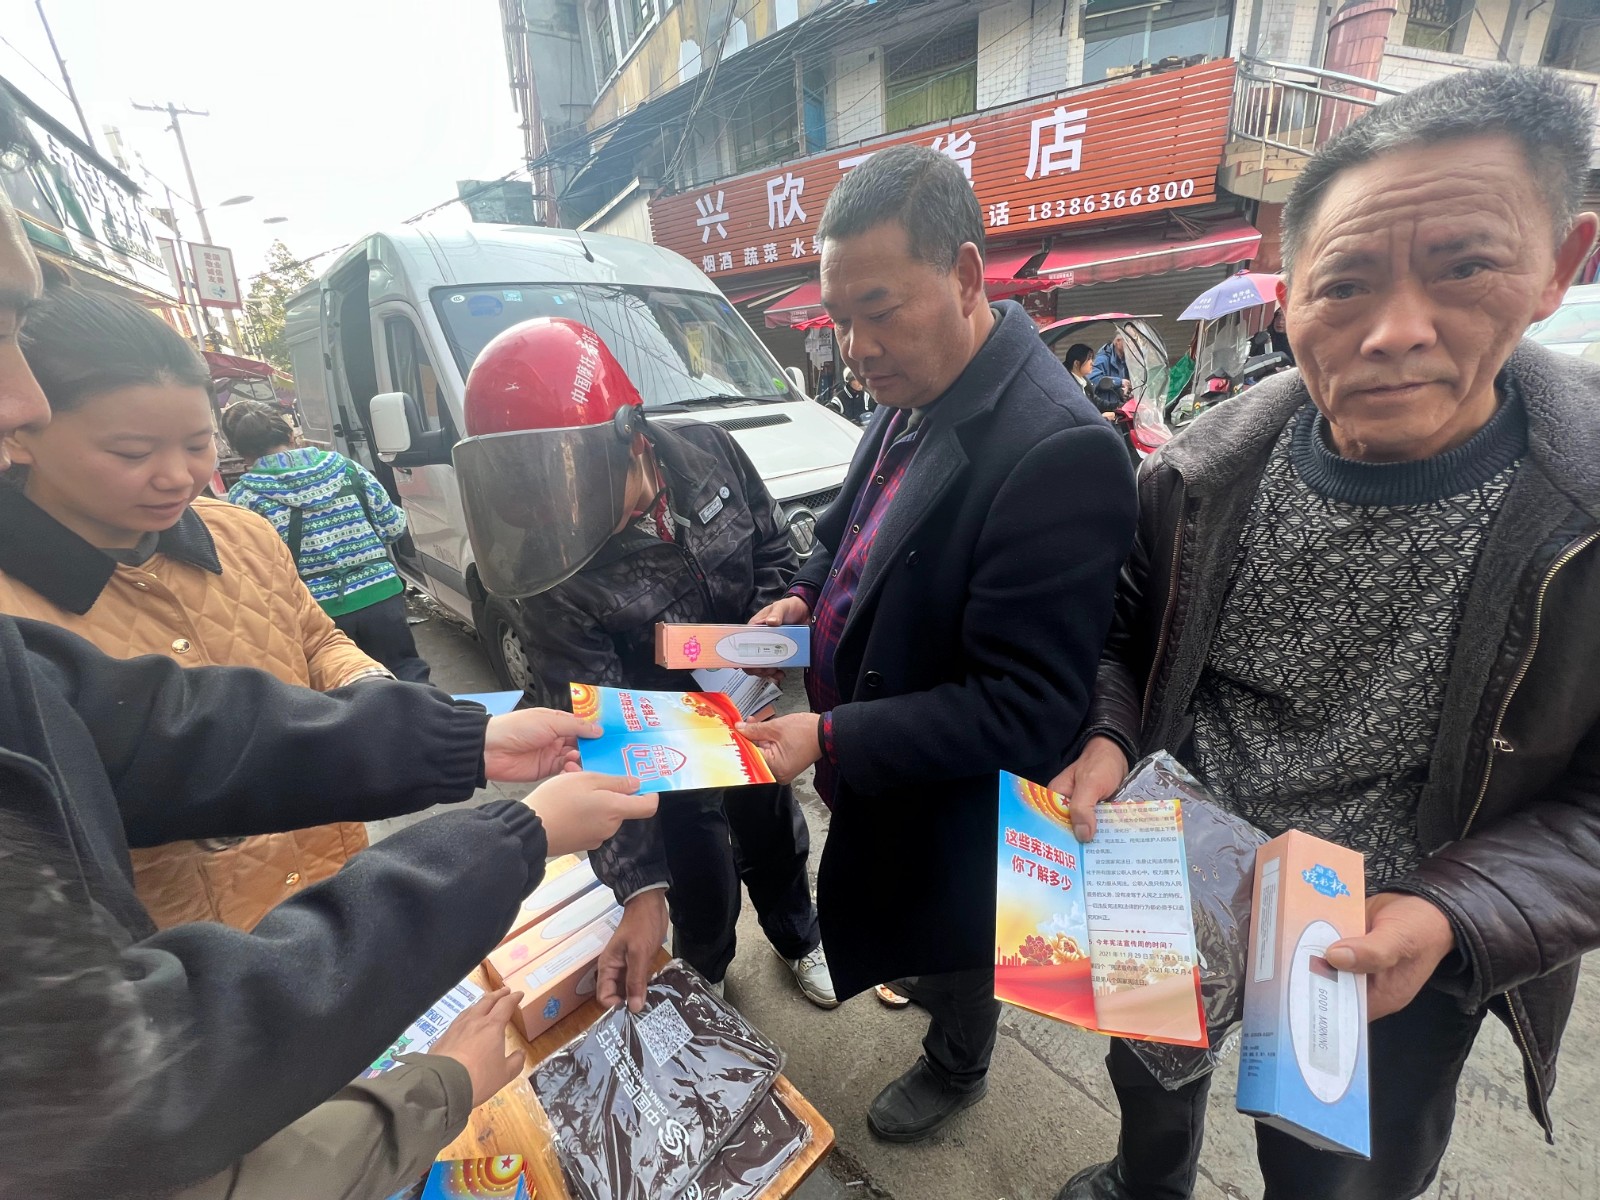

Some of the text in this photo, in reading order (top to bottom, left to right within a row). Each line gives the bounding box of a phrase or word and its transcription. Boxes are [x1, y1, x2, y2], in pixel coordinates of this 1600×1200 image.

[1026, 178, 1195, 222] 18386366800
[702, 251, 733, 273] 烟酒
[743, 242, 778, 266] 蔬菜
[1005, 827, 1077, 871] 这些宪法知识
[1012, 854, 1072, 891] 你了解多少
[595, 1028, 662, 1127] 中国民生银行
[608, 1021, 669, 1117] CHINA MINSHENG BANK
